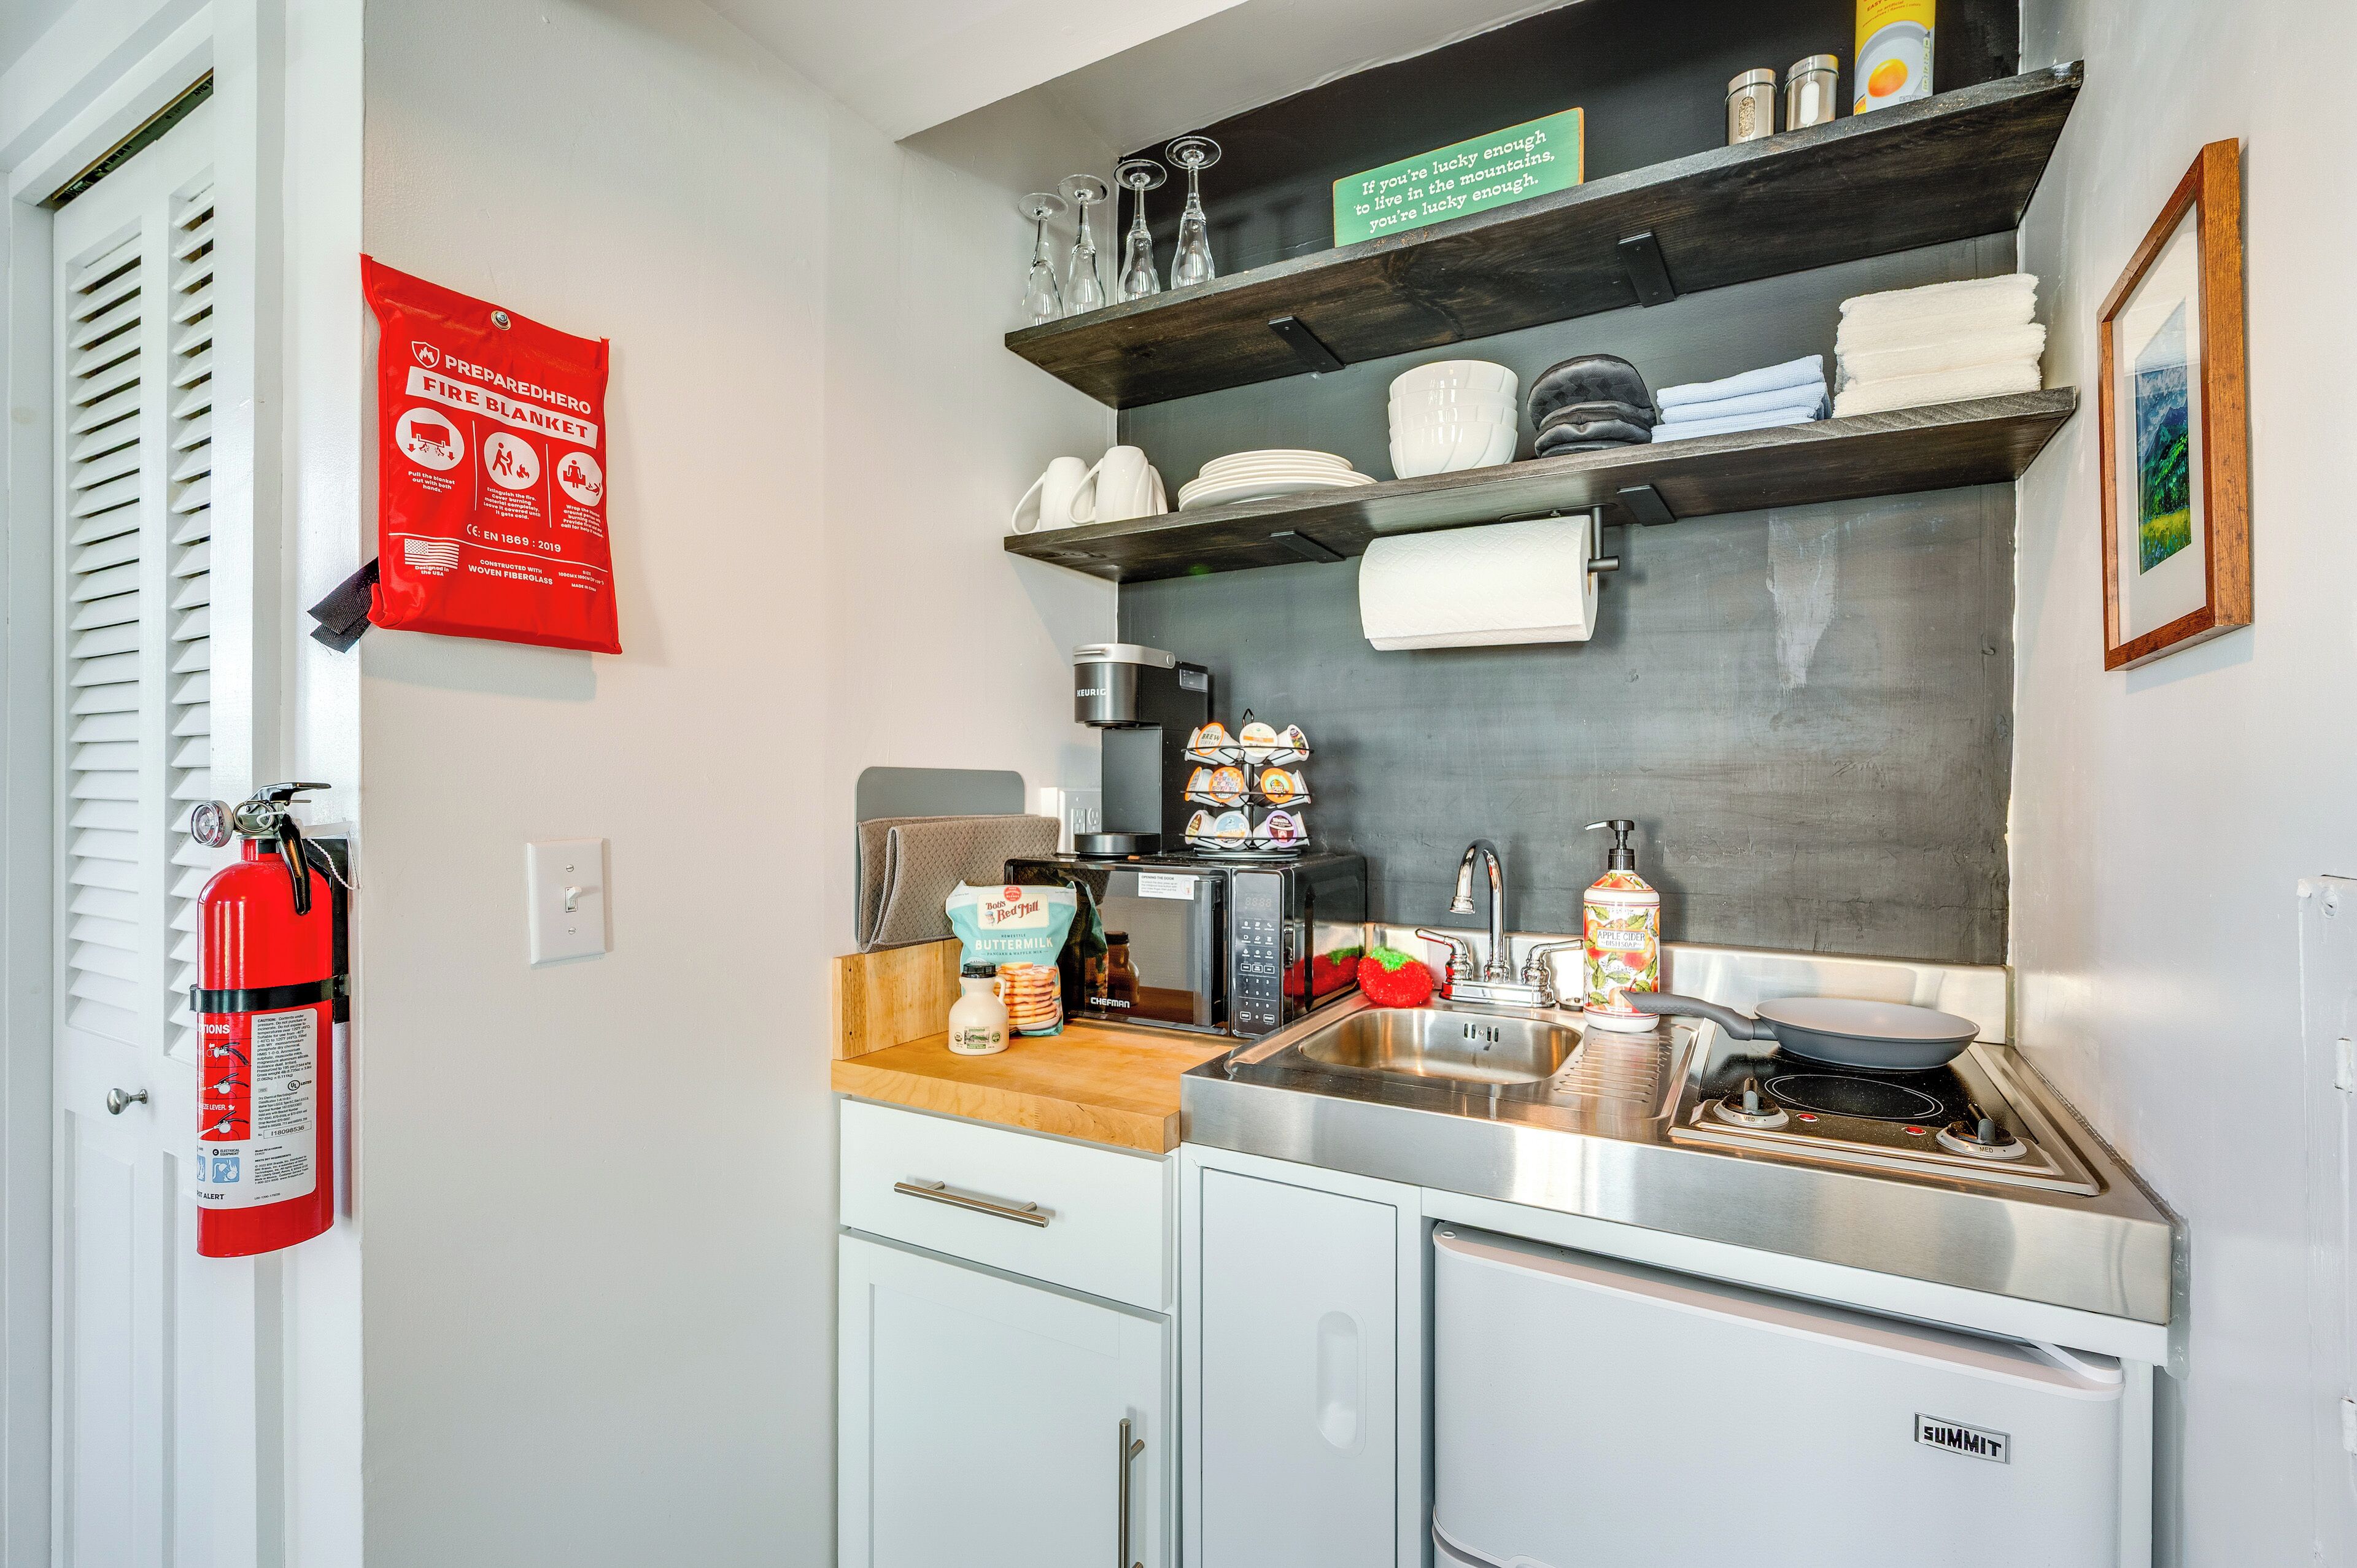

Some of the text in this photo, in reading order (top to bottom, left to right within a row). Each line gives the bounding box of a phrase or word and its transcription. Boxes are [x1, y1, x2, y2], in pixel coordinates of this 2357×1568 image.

[1867, 0, 1881, 12] EASY
[1362, 129, 1546, 195] If you're lucky enough
[1355, 154, 1555, 216] to live in the mountains,
[1369, 173, 1539, 233] you're lucky enough.
[445, 355, 591, 414] PREPAREDHERO
[423, 377, 587, 438] FIRE BLANKET
[433, 476, 455, 484] blanket
[487, 487, 514, 496] Extinguish
[484, 531, 498, 541] EN
[501, 534, 529, 546] 1869
[538, 541, 561, 552] 2019
[480, 560, 526, 571] CONSTRUCTED
[468, 565, 552, 585] WOVEN FIBERGLASS
[1077, 689, 1106, 697] KEURIG
[986, 900, 1006, 910] Bob's
[997, 900, 1040, 924] Red Mill
[1598, 931, 1620, 940] APPLE
[975, 938, 1053, 950] BUTTERMILK
[1091, 997, 1130, 1008] CHEFMAN
[204, 1024, 230, 1034] TIONS
[1924, 1426, 2002, 1457] SUMMIT
